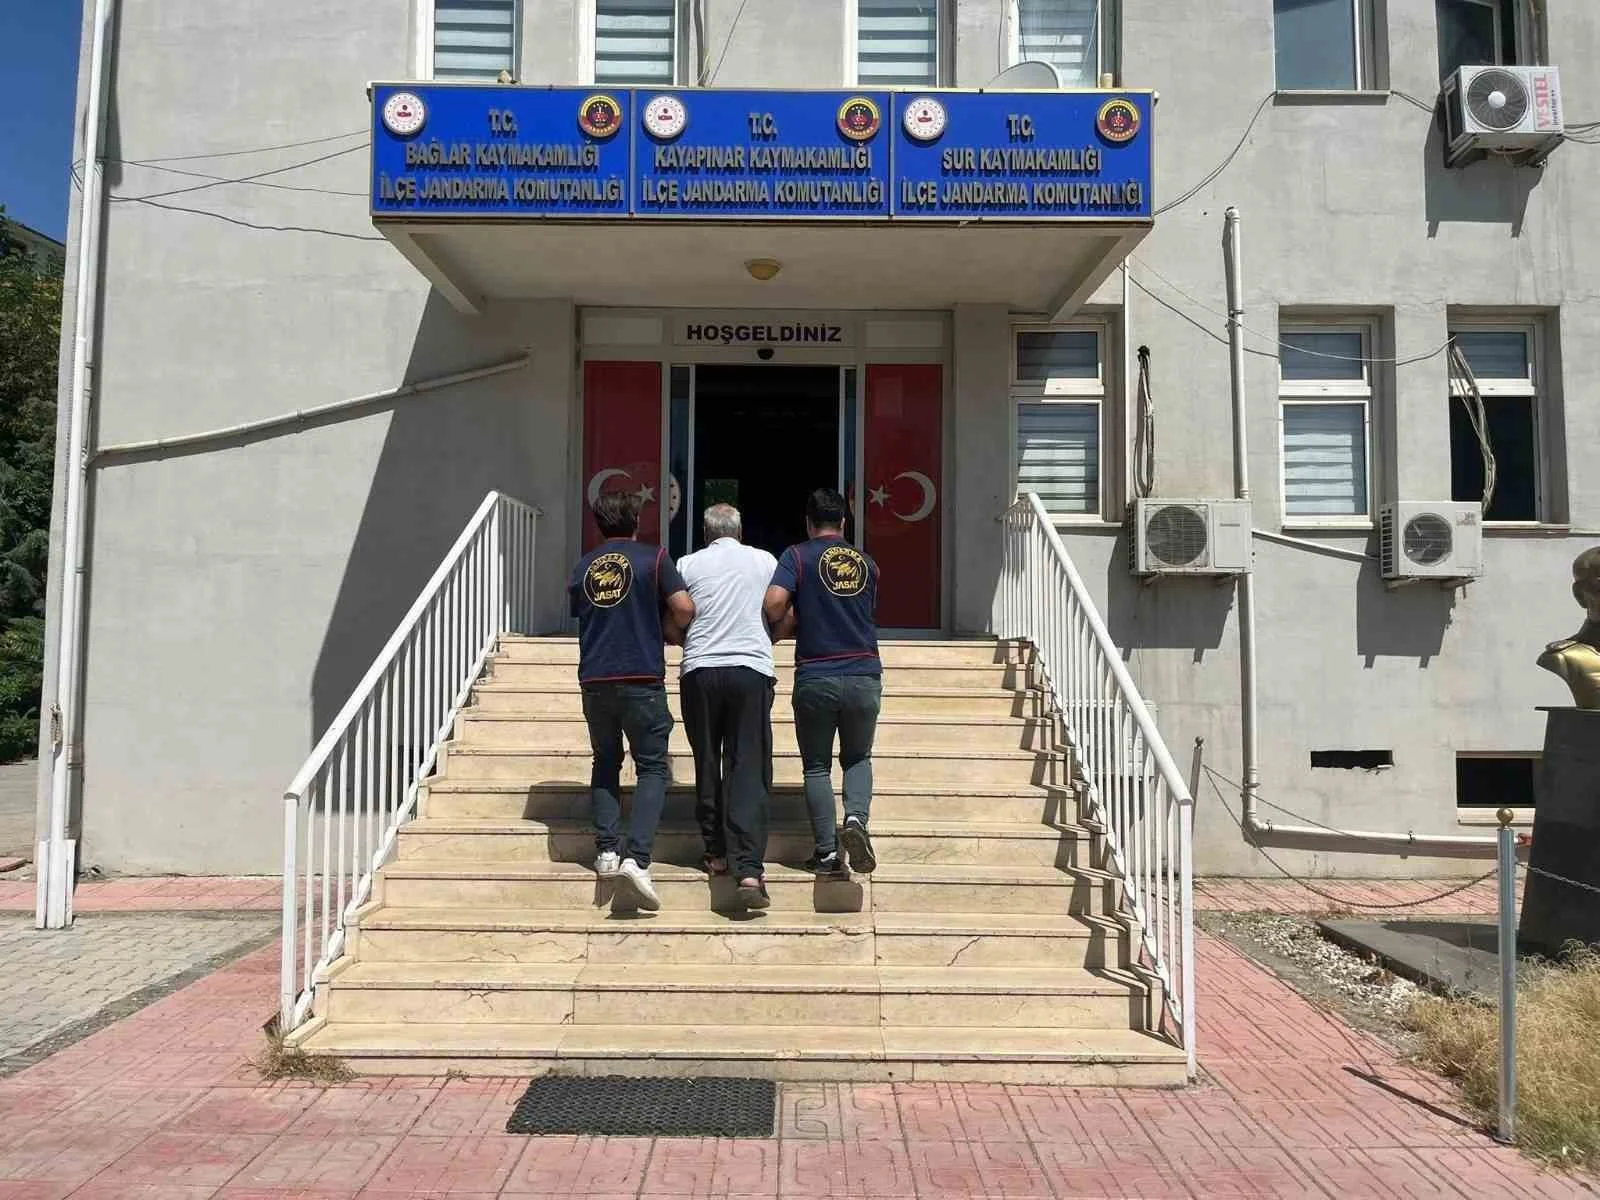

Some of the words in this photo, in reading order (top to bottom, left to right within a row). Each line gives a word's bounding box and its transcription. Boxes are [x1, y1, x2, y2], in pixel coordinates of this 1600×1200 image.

[488, 109, 517, 132] T.C.
[748, 113, 777, 135] T.C.
[1008, 114, 1035, 136] T.C.
[406, 138, 470, 165] BAĞLAR
[476, 139, 599, 167] KAYMAKAMLIĞI
[655, 145, 744, 168] KAYAPINAR
[749, 142, 871, 169] KAYMAKAMLIĞI
[943, 149, 976, 170] SUR
[980, 145, 1101, 171] KAYMAKAMLIĞI
[380, 172, 416, 201] İLÇE
[420, 176, 509, 200] JANDARMA
[514, 174, 624, 201] KOMUTANLIĞI
[642, 175, 679, 203] İLÇE
[683, 179, 769, 202] JANDARMA
[774, 176, 884, 203] KOMUTANLIĞI
[902, 176, 937, 204] İLÇE
[942, 180, 1029, 204] JANDARMA
[1034, 178, 1142, 204] KOMUTANLIĞI
[687, 322, 842, 345] HOŞGELDİNİZ
[594, 589, 621, 601] JASAT
[833, 580, 860, 591] JASAT
